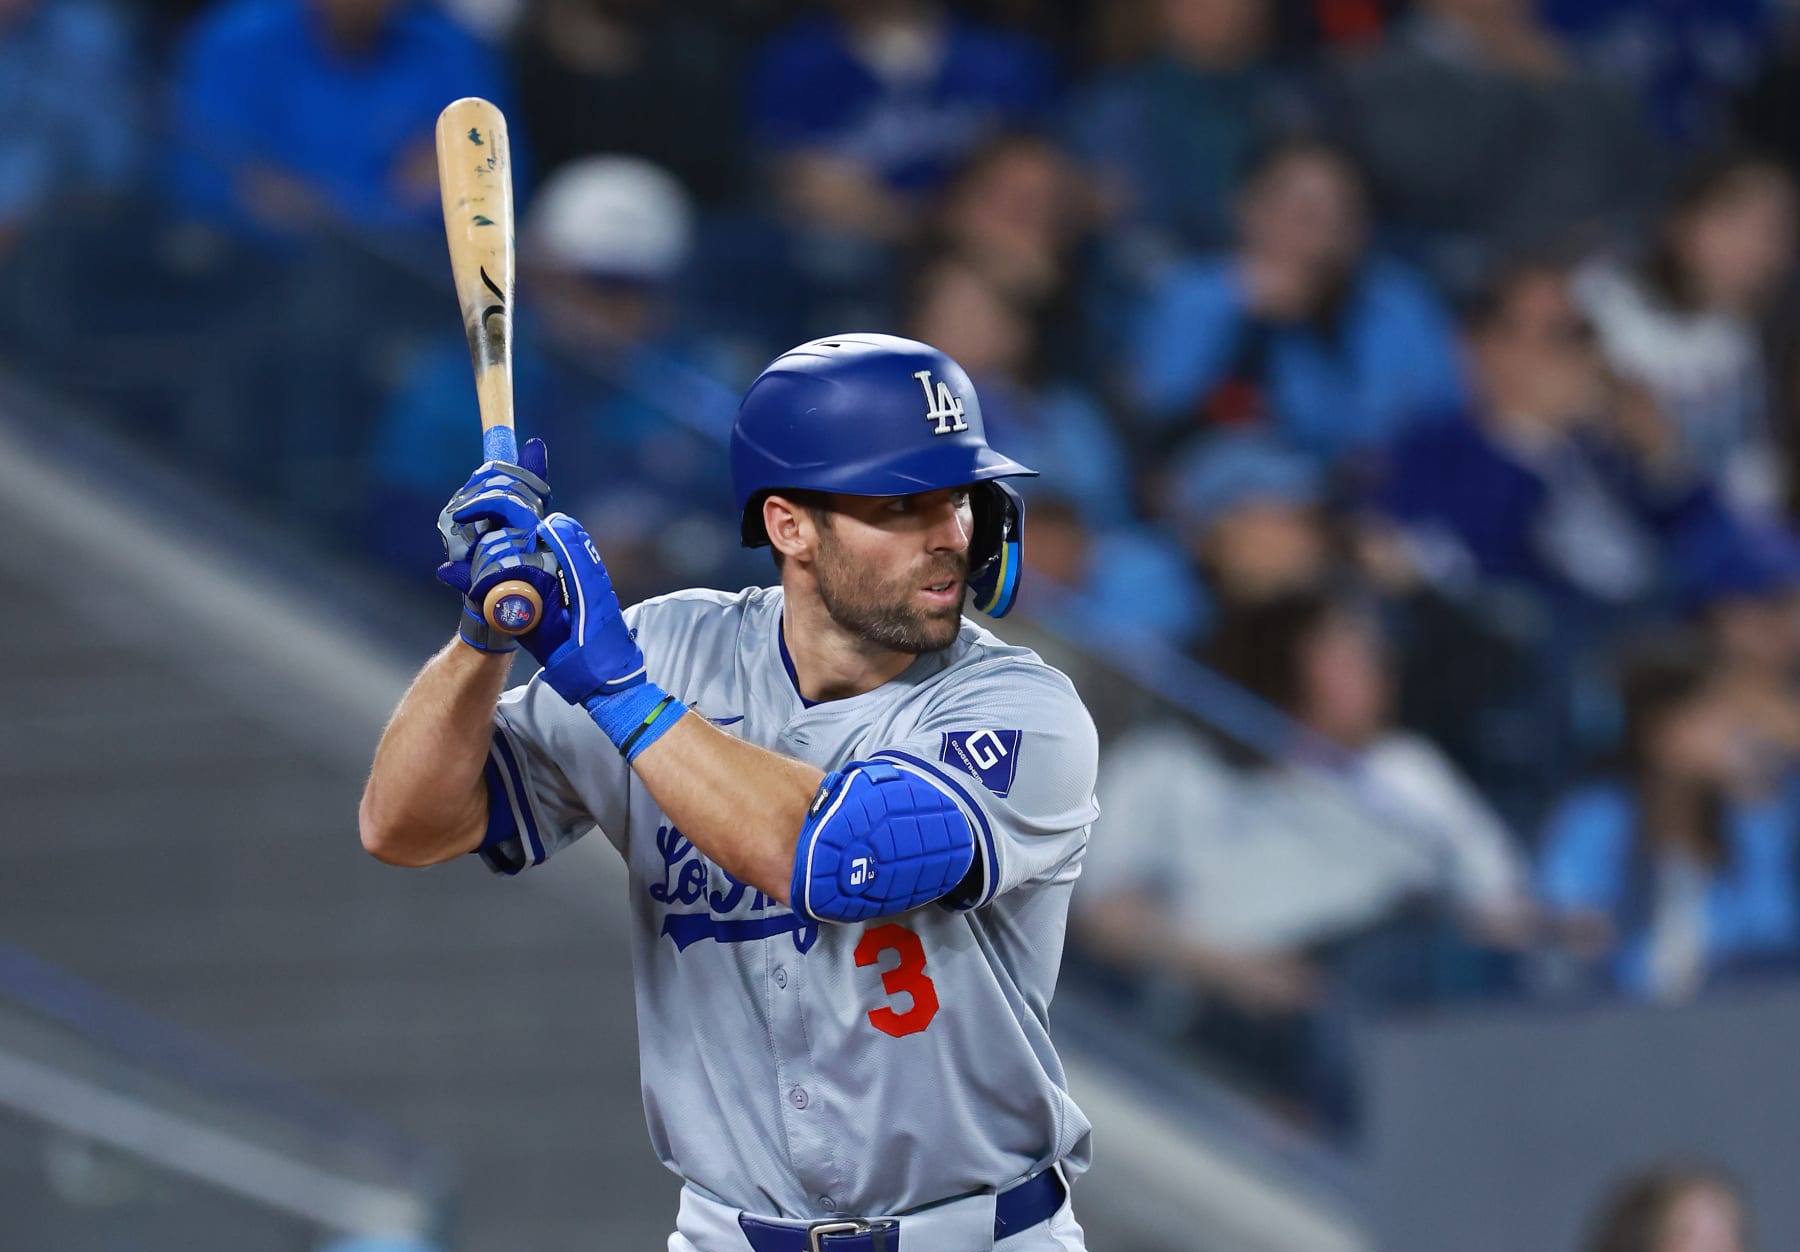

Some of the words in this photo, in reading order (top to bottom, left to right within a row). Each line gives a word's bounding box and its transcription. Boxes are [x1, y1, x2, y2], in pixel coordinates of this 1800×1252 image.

[913, 370, 968, 435] LA
[966, 730, 1008, 770] G
[853, 923, 940, 1038] 3
